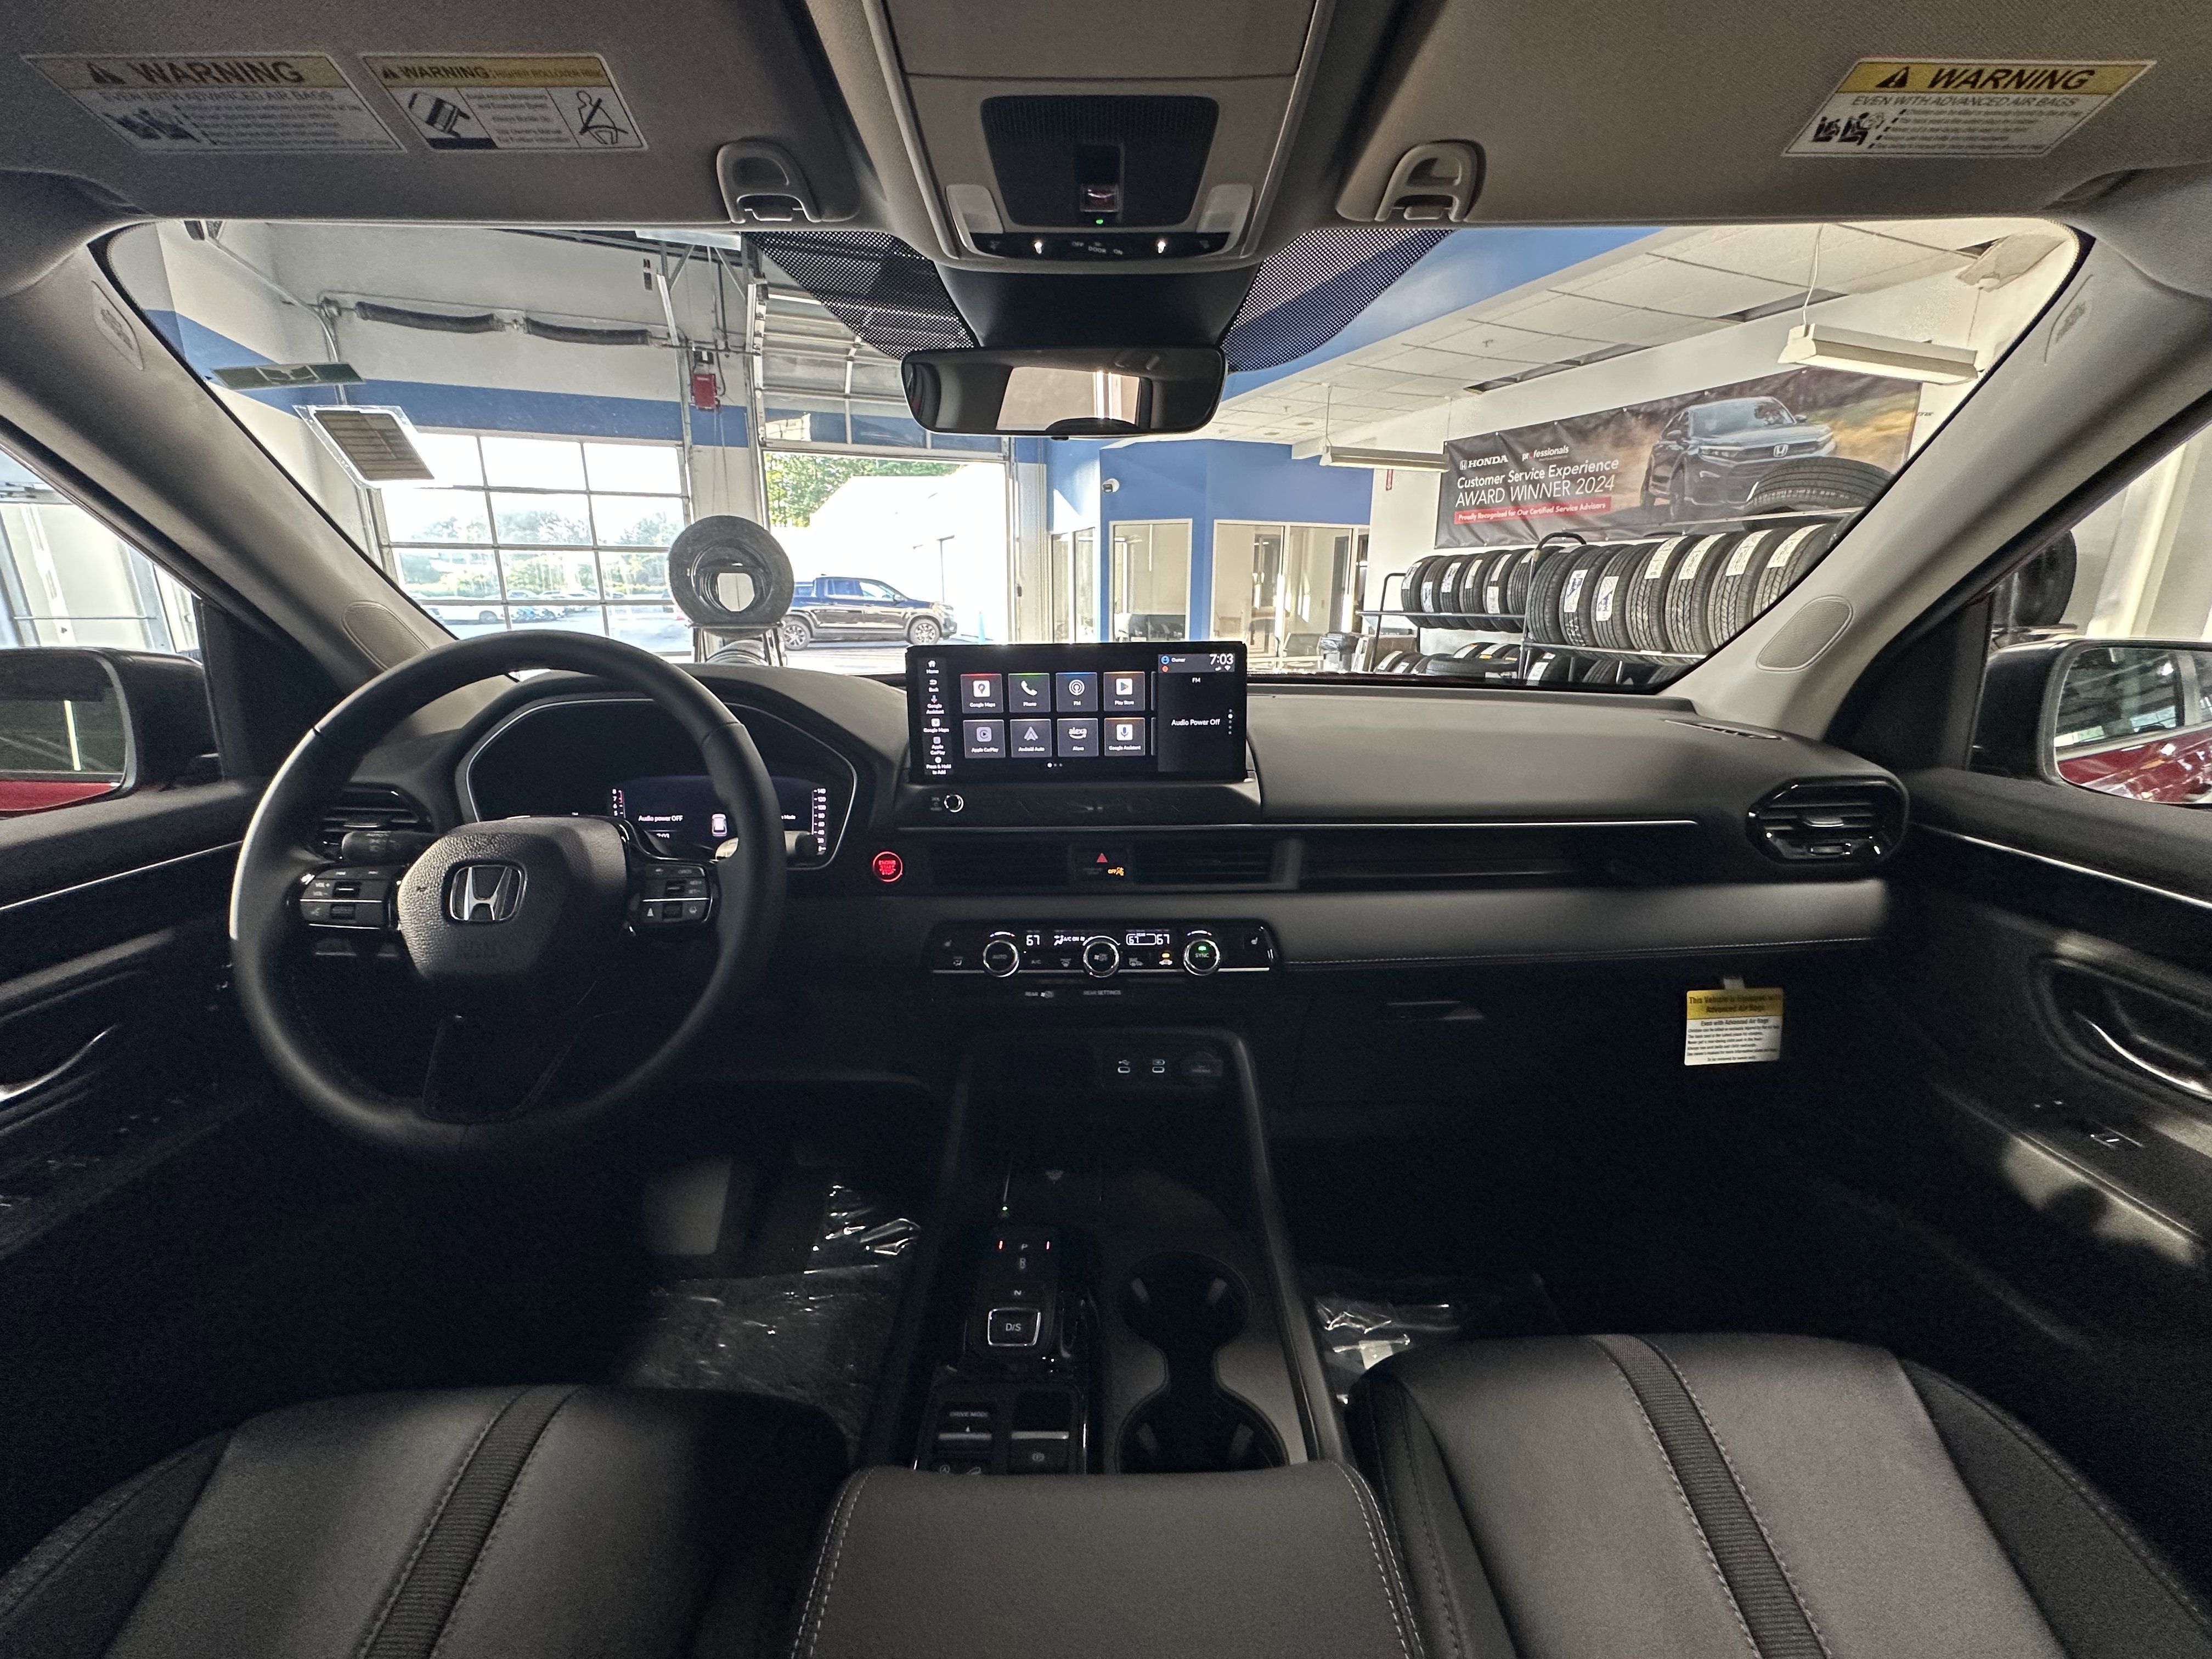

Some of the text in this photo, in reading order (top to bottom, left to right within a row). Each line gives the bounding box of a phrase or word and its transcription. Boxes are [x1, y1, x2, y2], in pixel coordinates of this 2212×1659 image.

[125, 61, 305, 84] WARNING
[1927, 68, 2096, 90] WARNING
[1852, 95, 2079, 107] EVEN WITH ADVANCED AIR BAGS
[1088, 246, 1107, 255] DOOR
[1522, 445, 1570, 461] professionals
[1468, 455, 1509, 468] HONDA
[1457, 475, 1505, 489] Customer
[1507, 469, 1545, 483] Service
[1548, 458, 1620, 479] Experience
[1455, 474, 1616, 507] AWARD WINNER 2024
[1477, 511, 1508, 520] Recognized
[1529, 506, 1554, 515] Certified
[1555, 505, 1578, 513] Service
[1579, 502, 1606, 511] Advisors
[1209, 653, 1234, 665] 7:03
[1068, 726, 1087, 736] alexa
[1025, 934, 1041, 946] 67
[1156, 934, 1170, 945] 67
[1005, 1323, 1022, 1331] D/S
